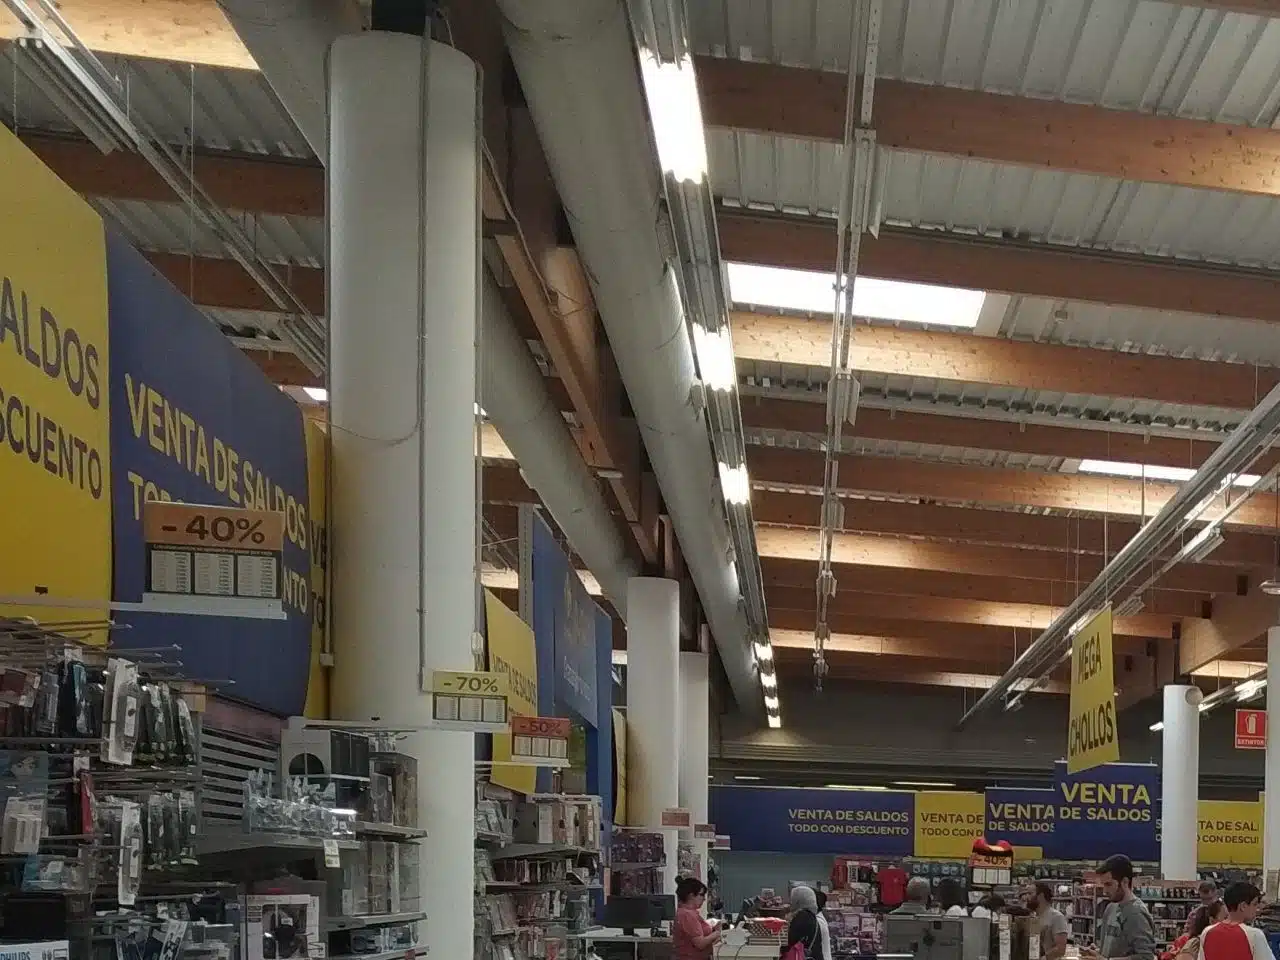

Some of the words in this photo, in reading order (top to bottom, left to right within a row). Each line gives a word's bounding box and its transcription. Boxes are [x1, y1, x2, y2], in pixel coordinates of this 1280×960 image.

[124, 372, 211, 485] VENTA
[212, 435, 241, 505] DE
[1077, 632, 1102, 684] MEGA
[1070, 700, 1114, 758] CHOLLOS
[1060, 781, 1152, 805] VENTA
[788, 808, 834, 820] VENTA
[835, 810, 854, 821] DE
[856, 810, 909, 822] SALDOS
[989, 802, 1055, 819] VENTA
[1059, 806, 1082, 820] DE
[1086, 807, 1151, 822] SALDOS
[920, 812, 964, 824] VENTA
[966, 814, 984, 825] DE
[988, 820, 1006, 831] DE
[1216, 820, 1233, 831] DE
[1234, 821, 1259, 831] SAL
[788, 823, 819, 833] TODO
[820, 824, 844, 834] CON
[846, 825, 909, 836] DESCUENTO
[921, 827, 950, 837] TODO
[951, 828, 974, 837] CON
[1202, 834, 1223, 843] CON
[1224, 835, 1259, 844] DESCU
